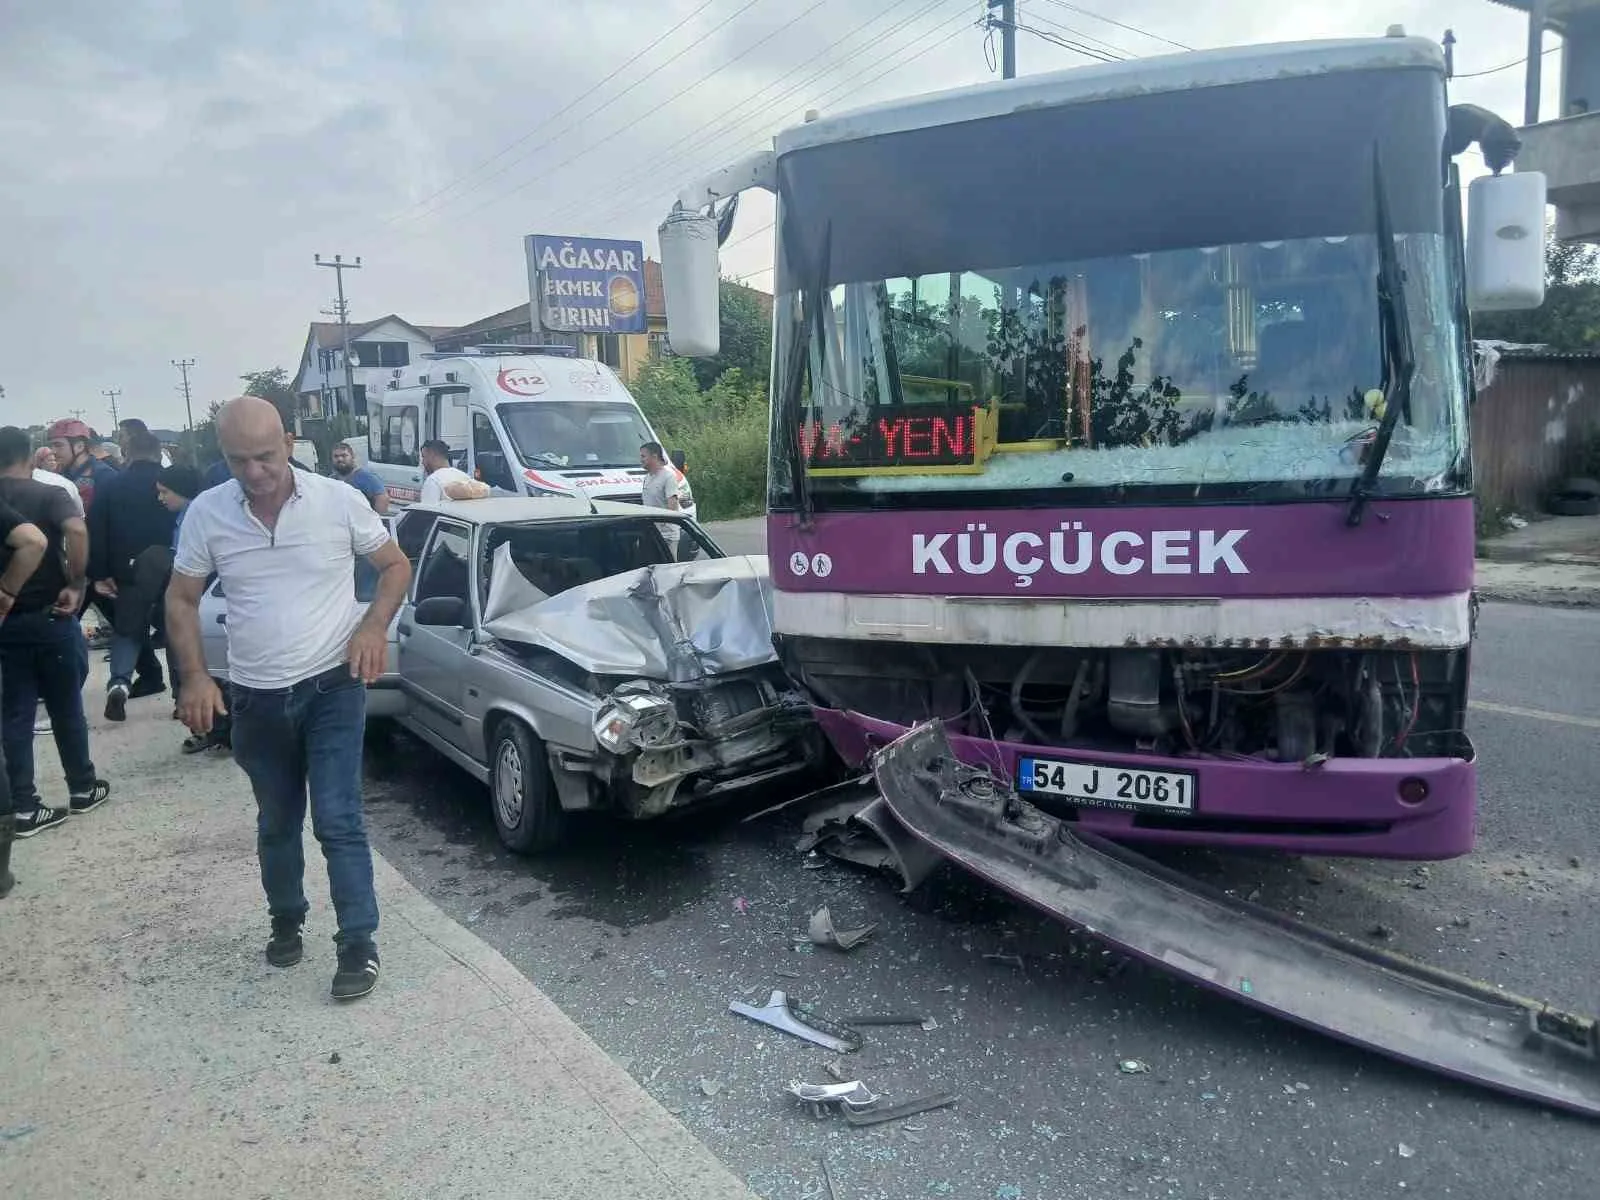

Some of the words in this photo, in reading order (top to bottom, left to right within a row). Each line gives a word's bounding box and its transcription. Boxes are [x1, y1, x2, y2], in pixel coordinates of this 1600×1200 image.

[541, 241, 638, 271] AĞASAR
[544, 279, 604, 297] EKMEK
[505, 375, 545, 386] 112
[911, 521, 1250, 588] KÜÇÜCEK
[1034, 763, 1066, 791] 54
[1083, 770, 1099, 794] J
[1117, 772, 1186, 804] 2061
